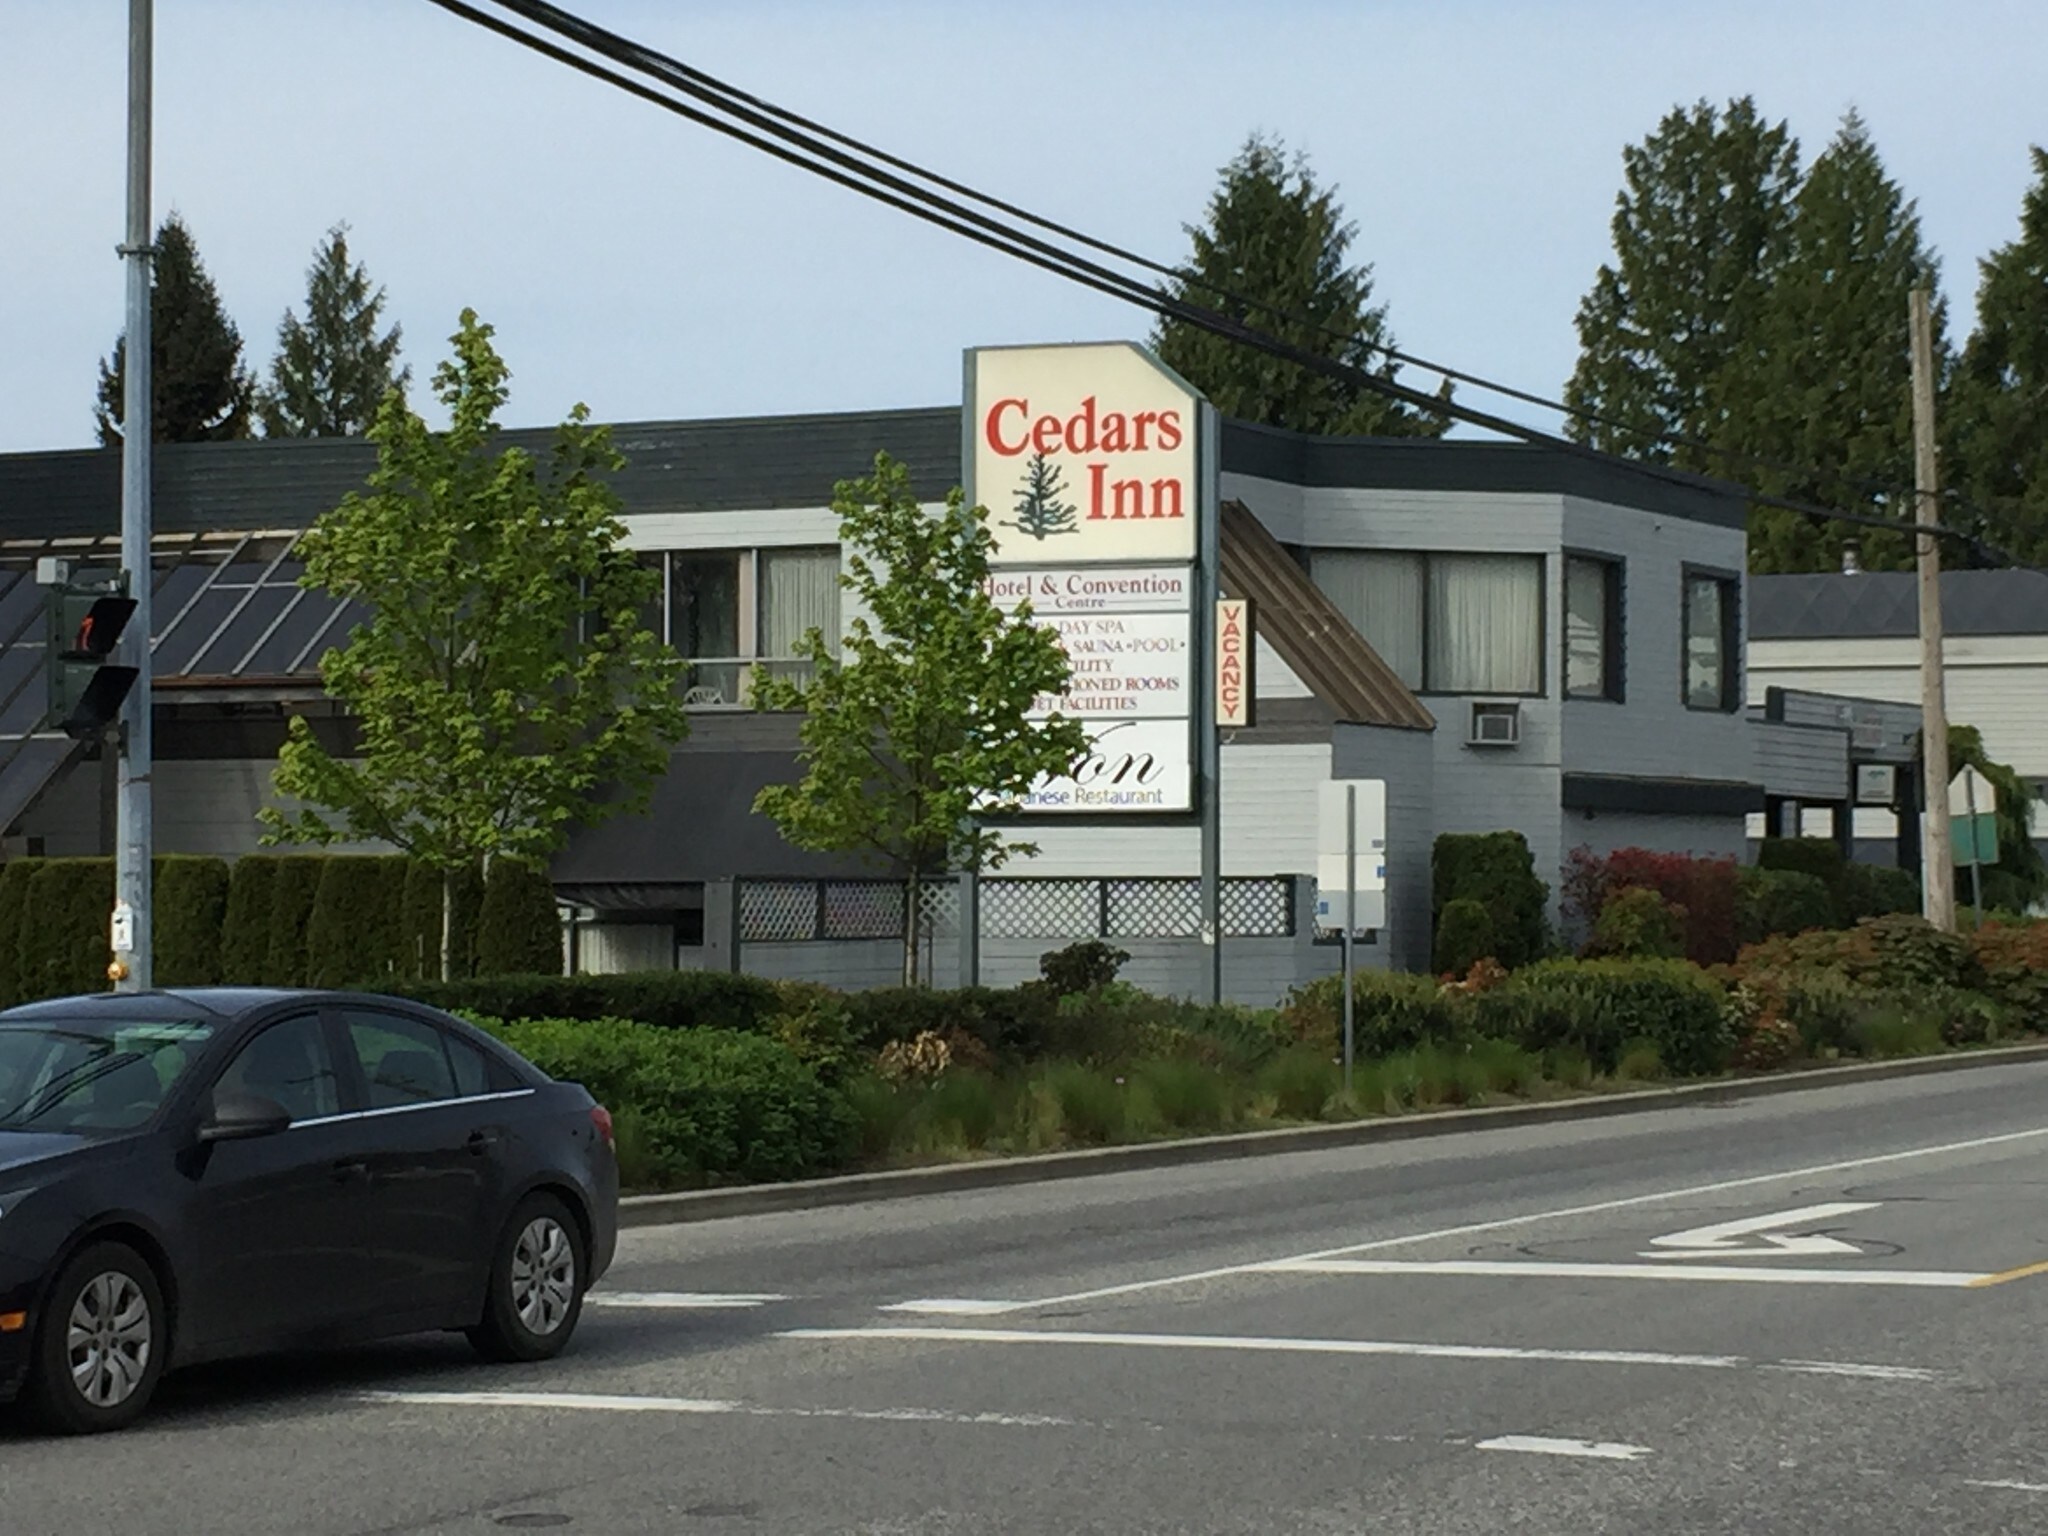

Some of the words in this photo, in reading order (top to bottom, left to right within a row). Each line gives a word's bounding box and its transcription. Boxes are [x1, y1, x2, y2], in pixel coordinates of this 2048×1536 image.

[986, 395, 1182, 456] Cedars
[1086, 463, 1184, 520] Inn
[982, 576, 1031, 596] Hotel
[1040, 575, 1058, 595] &
[1066, 574, 1182, 595] Convention
[1055, 596, 1106, 609] Centre
[1060, 620, 1091, 634] DAY
[1096, 620, 1125, 634] SPA
[1073, 639, 1124, 653] SAUNA
[1073, 660, 1114, 673] ILITY
[1222, 606, 1241, 719] VACANCY
[1074, 678, 1121, 692] IONED
[1126, 677, 1180, 692] ROOMS
[1060, 696, 1138, 711] FACILITIES
[1075, 786, 1163, 804] Restaurant
